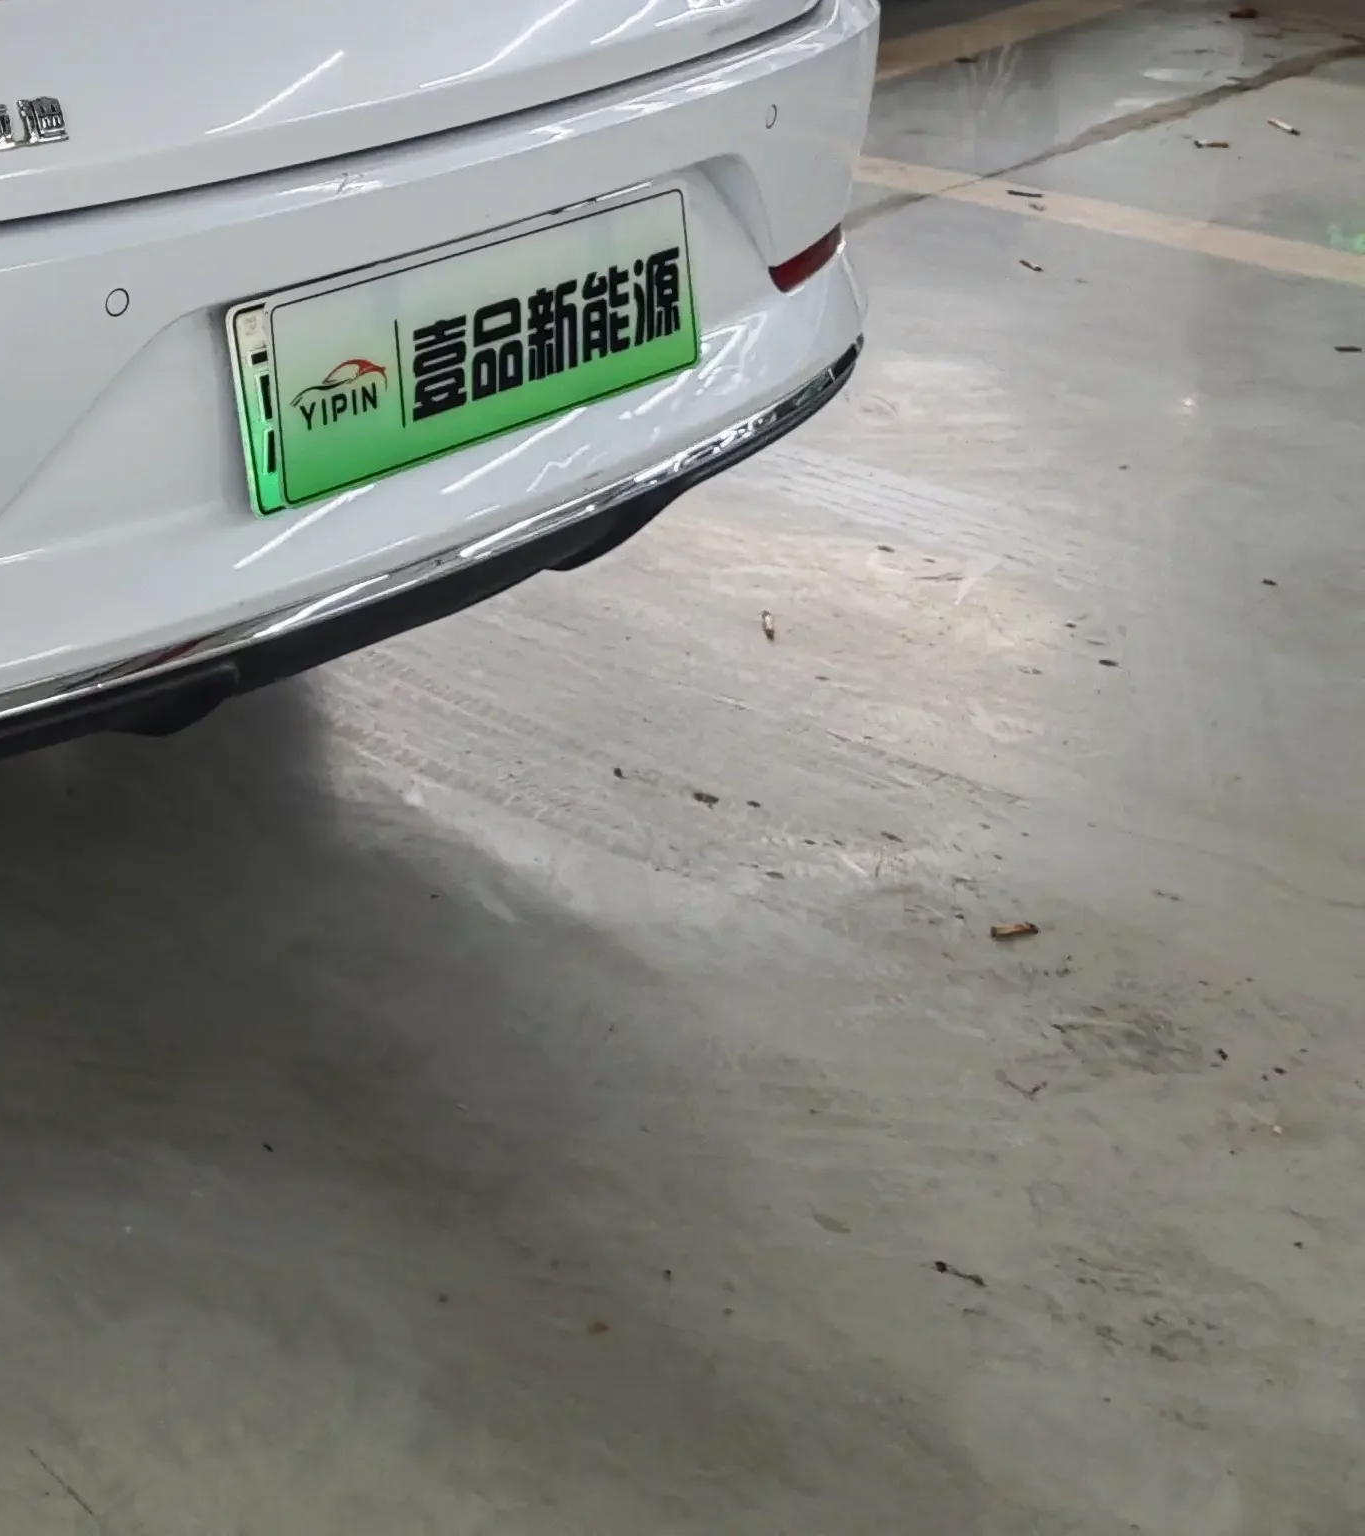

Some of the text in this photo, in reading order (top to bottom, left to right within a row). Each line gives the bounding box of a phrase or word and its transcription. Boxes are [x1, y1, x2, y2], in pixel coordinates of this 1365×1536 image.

[412, 246, 681, 423] 壹品新能源
[300, 382, 378, 431] YIPIN
